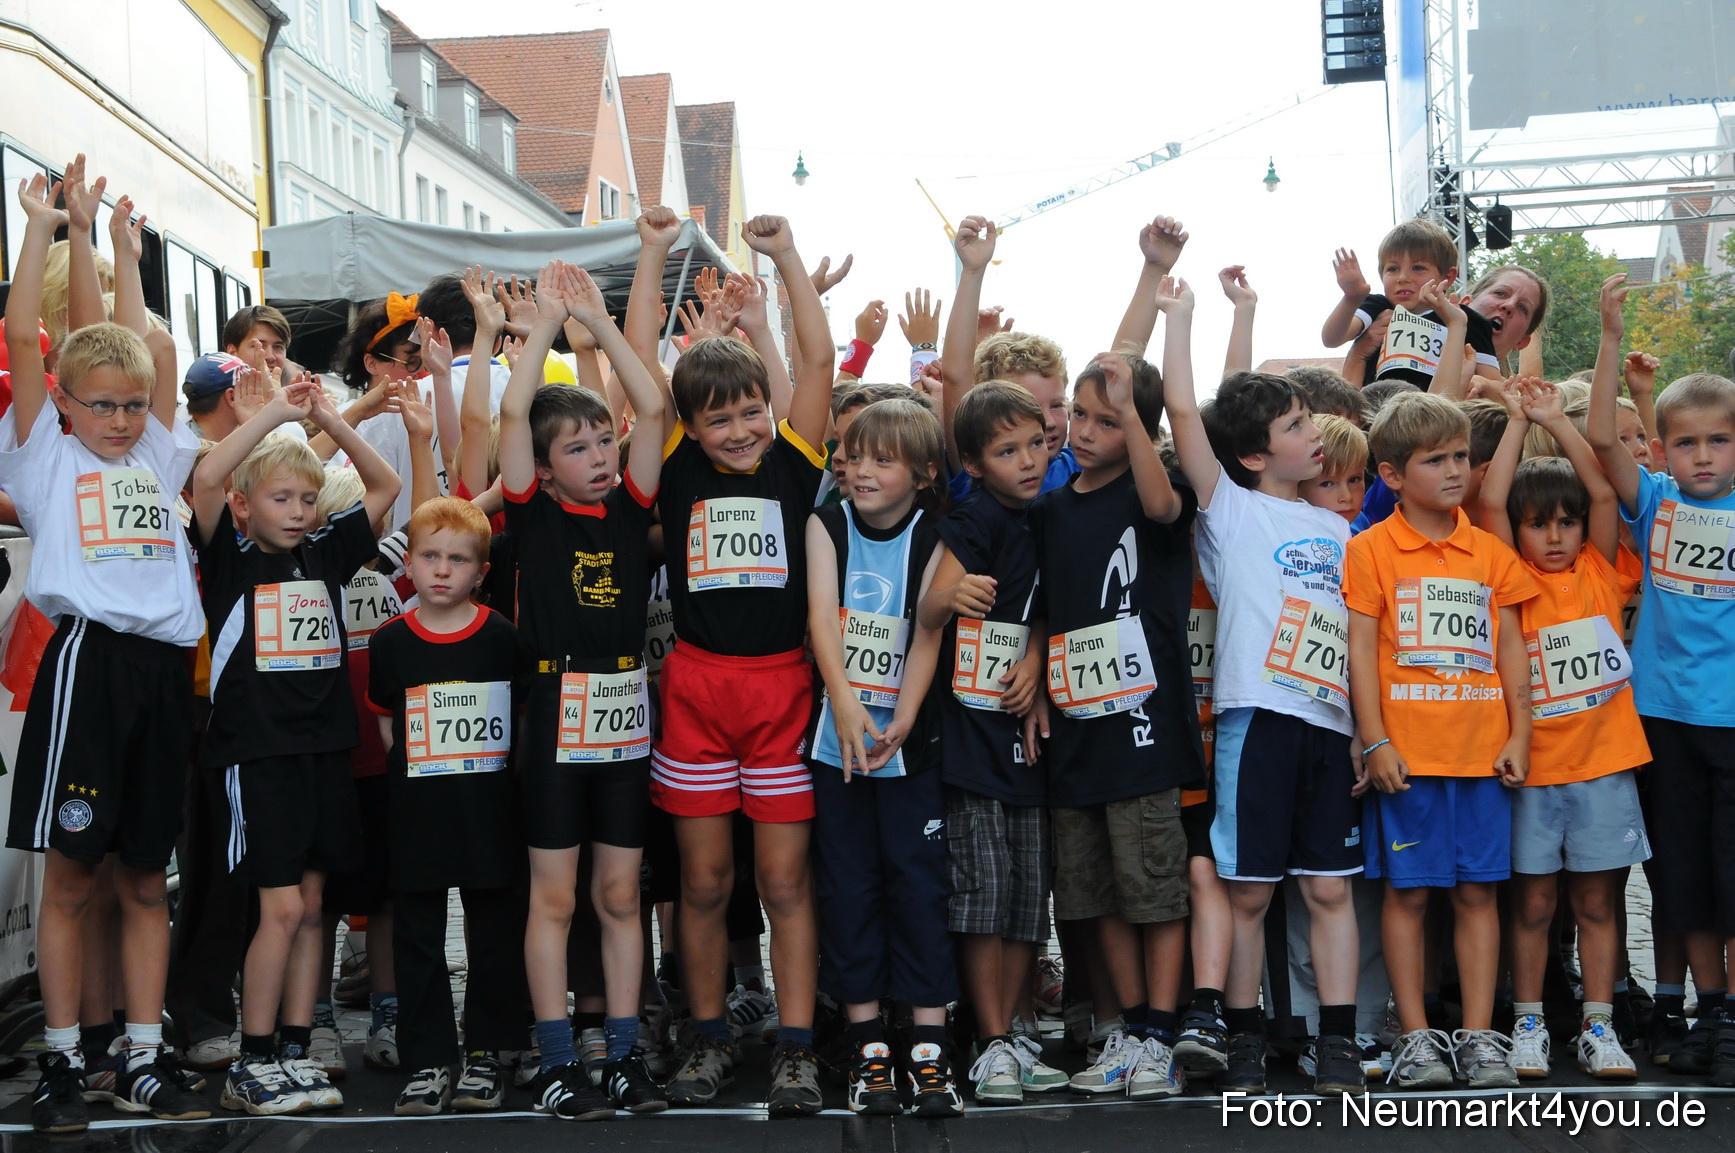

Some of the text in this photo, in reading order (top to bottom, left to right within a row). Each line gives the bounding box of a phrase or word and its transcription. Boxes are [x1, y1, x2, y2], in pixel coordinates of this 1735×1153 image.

[1036, 193, 1065, 209] POTAIN
[1391, 310, 1442, 332] Johannes
[1391, 329, 1443, 359] 7133
[113, 504, 170, 531] 7287
[710, 506, 756, 523] Lorenz
[690, 535, 701, 549] K4
[712, 532, 778, 558] 7008
[349, 596, 400, 622] 7143
[1399, 610, 1415, 624] K4
[288, 615, 336, 642] 7261
[848, 616, 890, 640] Stefan
[1279, 629, 1294, 645] K4
[1429, 612, 1489, 643] 7064
[985, 628, 1019, 649] Josua
[1068, 637, 1105, 656] Aaron
[1545, 633, 1571, 651] Jan
[845, 645, 904, 678] 7097
[961, 650, 974, 664] K4
[1304, 638, 1349, 684] 701
[1551, 647, 1622, 685] 7076
[985, 656, 1018, 680] 71
[1051, 667, 1062, 681] K4
[1071, 652, 1142, 690] 7115
[592, 678, 642, 698] Jonathan
[1390, 683, 1459, 701] MERZ
[433, 691, 478, 708] Simon
[564, 706, 579, 720] K4
[593, 703, 646, 733] 7020
[410, 719, 423, 734] K4
[436, 716, 504, 744] 7026
